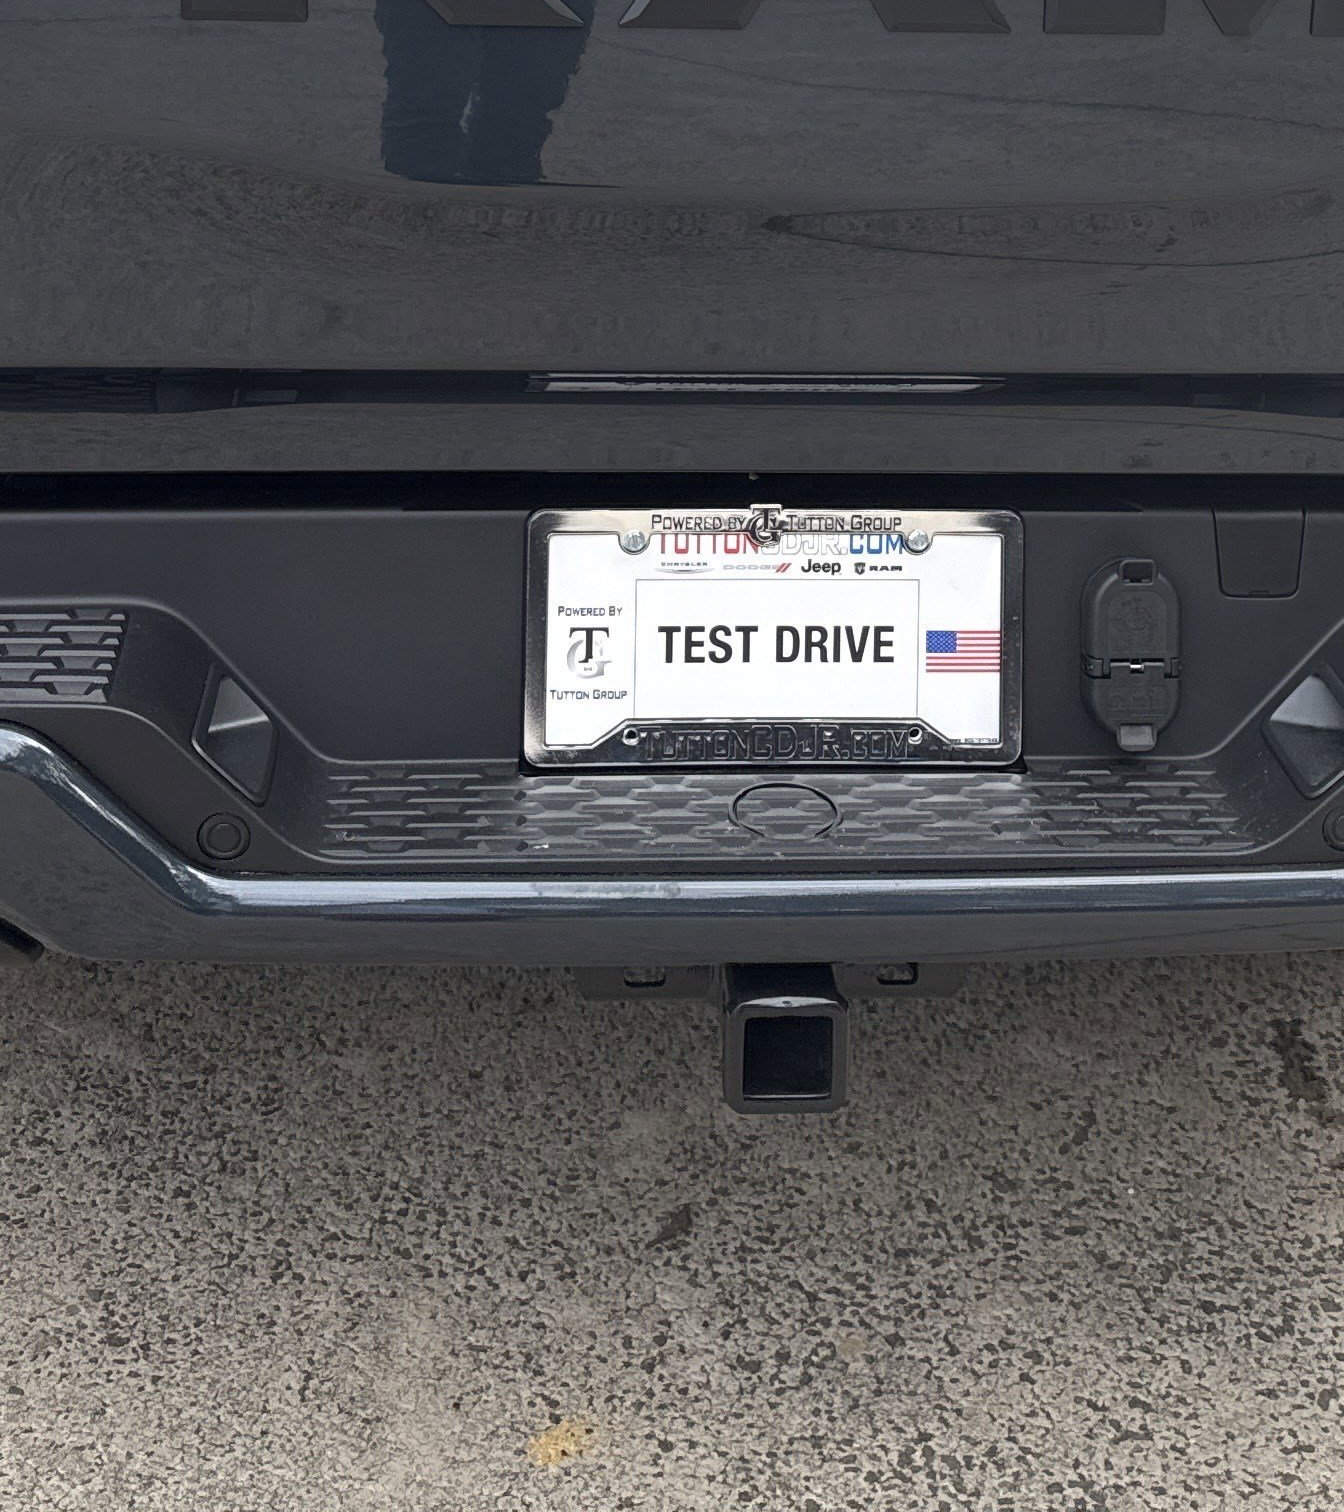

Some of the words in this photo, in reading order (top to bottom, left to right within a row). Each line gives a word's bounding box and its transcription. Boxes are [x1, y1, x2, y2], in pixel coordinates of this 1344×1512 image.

[800, 558, 841, 575] Jeep
[658, 625, 759, 664] TEST
[774, 625, 896, 664] DRIVE
